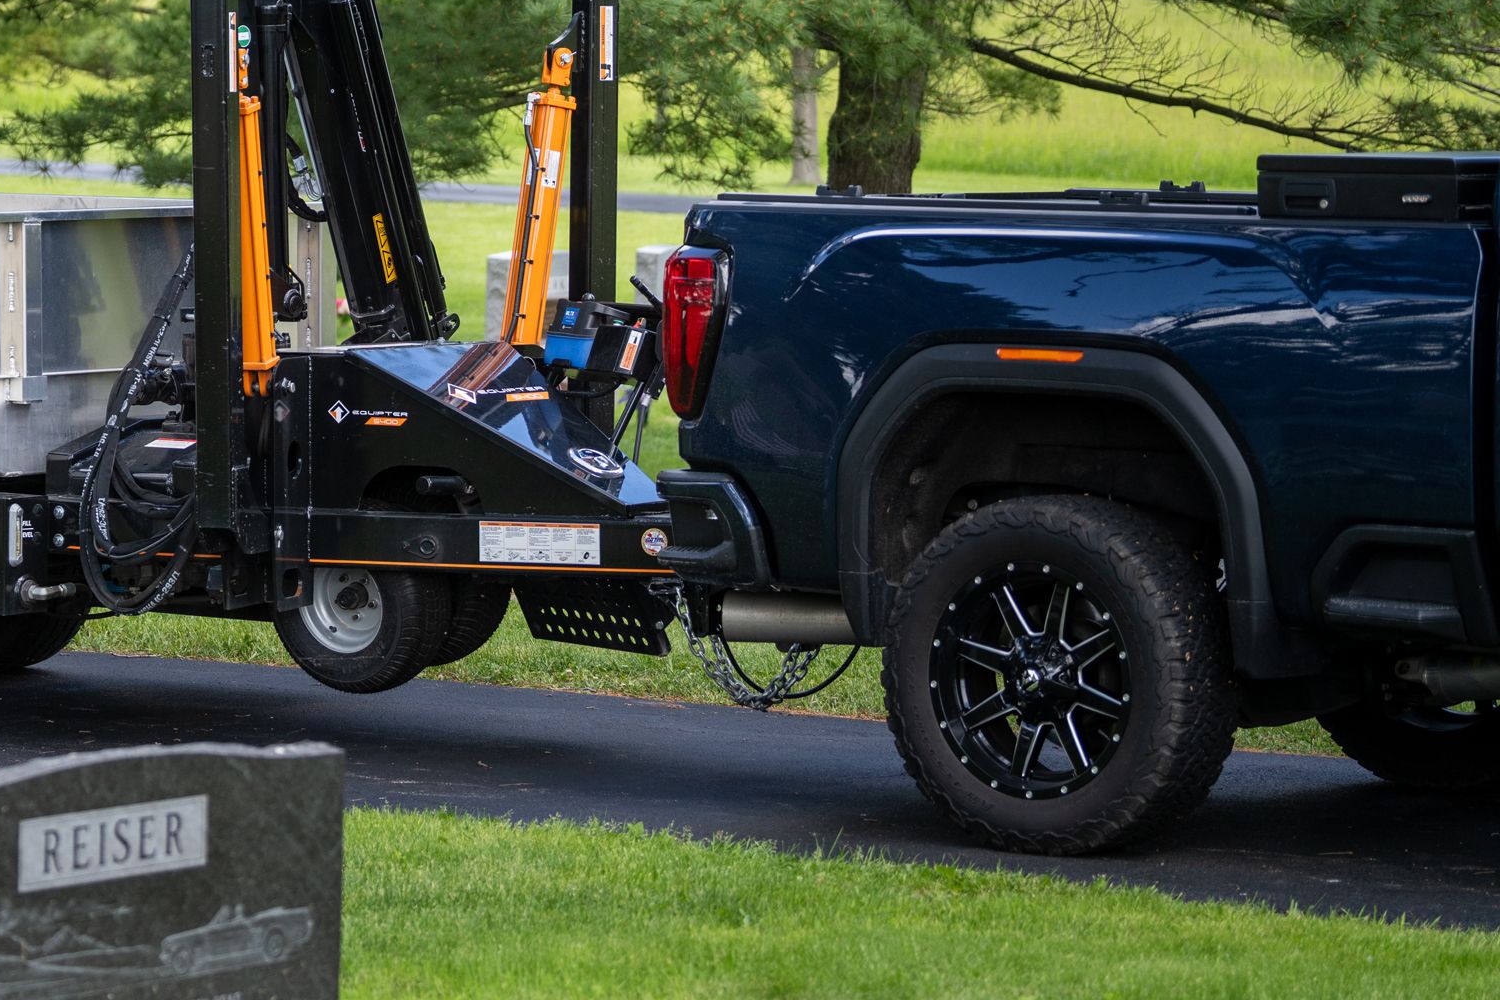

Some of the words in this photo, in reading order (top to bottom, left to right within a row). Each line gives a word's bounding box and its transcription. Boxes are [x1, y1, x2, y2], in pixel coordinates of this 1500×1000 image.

[477, 386, 545, 395] EQUIPTER
[352, 409, 409, 417] EQUIPTER
[43, 811, 184, 874] REISER
